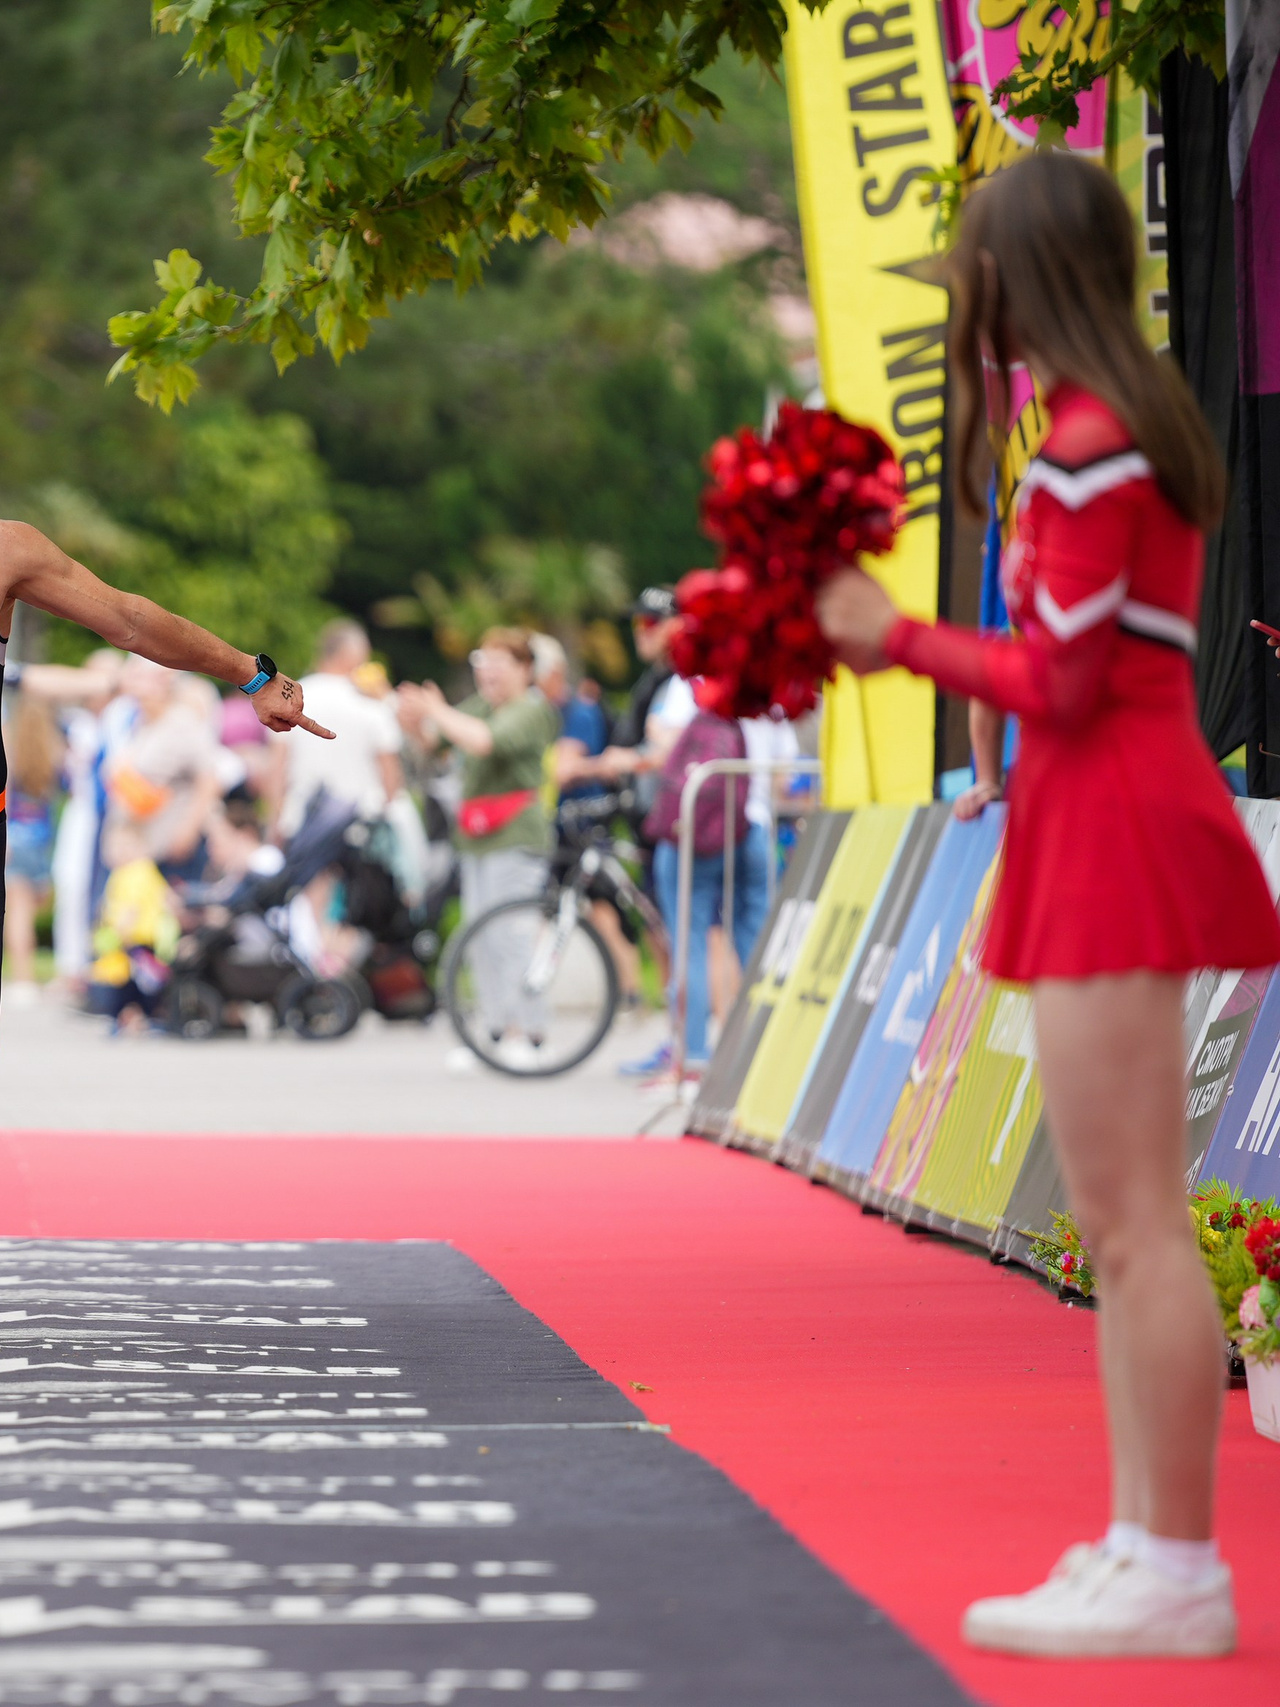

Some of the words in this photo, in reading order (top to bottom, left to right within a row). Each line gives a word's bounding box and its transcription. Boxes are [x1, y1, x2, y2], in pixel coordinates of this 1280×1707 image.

[842, 0, 943, 217] STAR
[281, 680, 295, 701] 454
[80, 1312, 369, 1325] STAR
[92, 1360, 401, 1375] STAR
